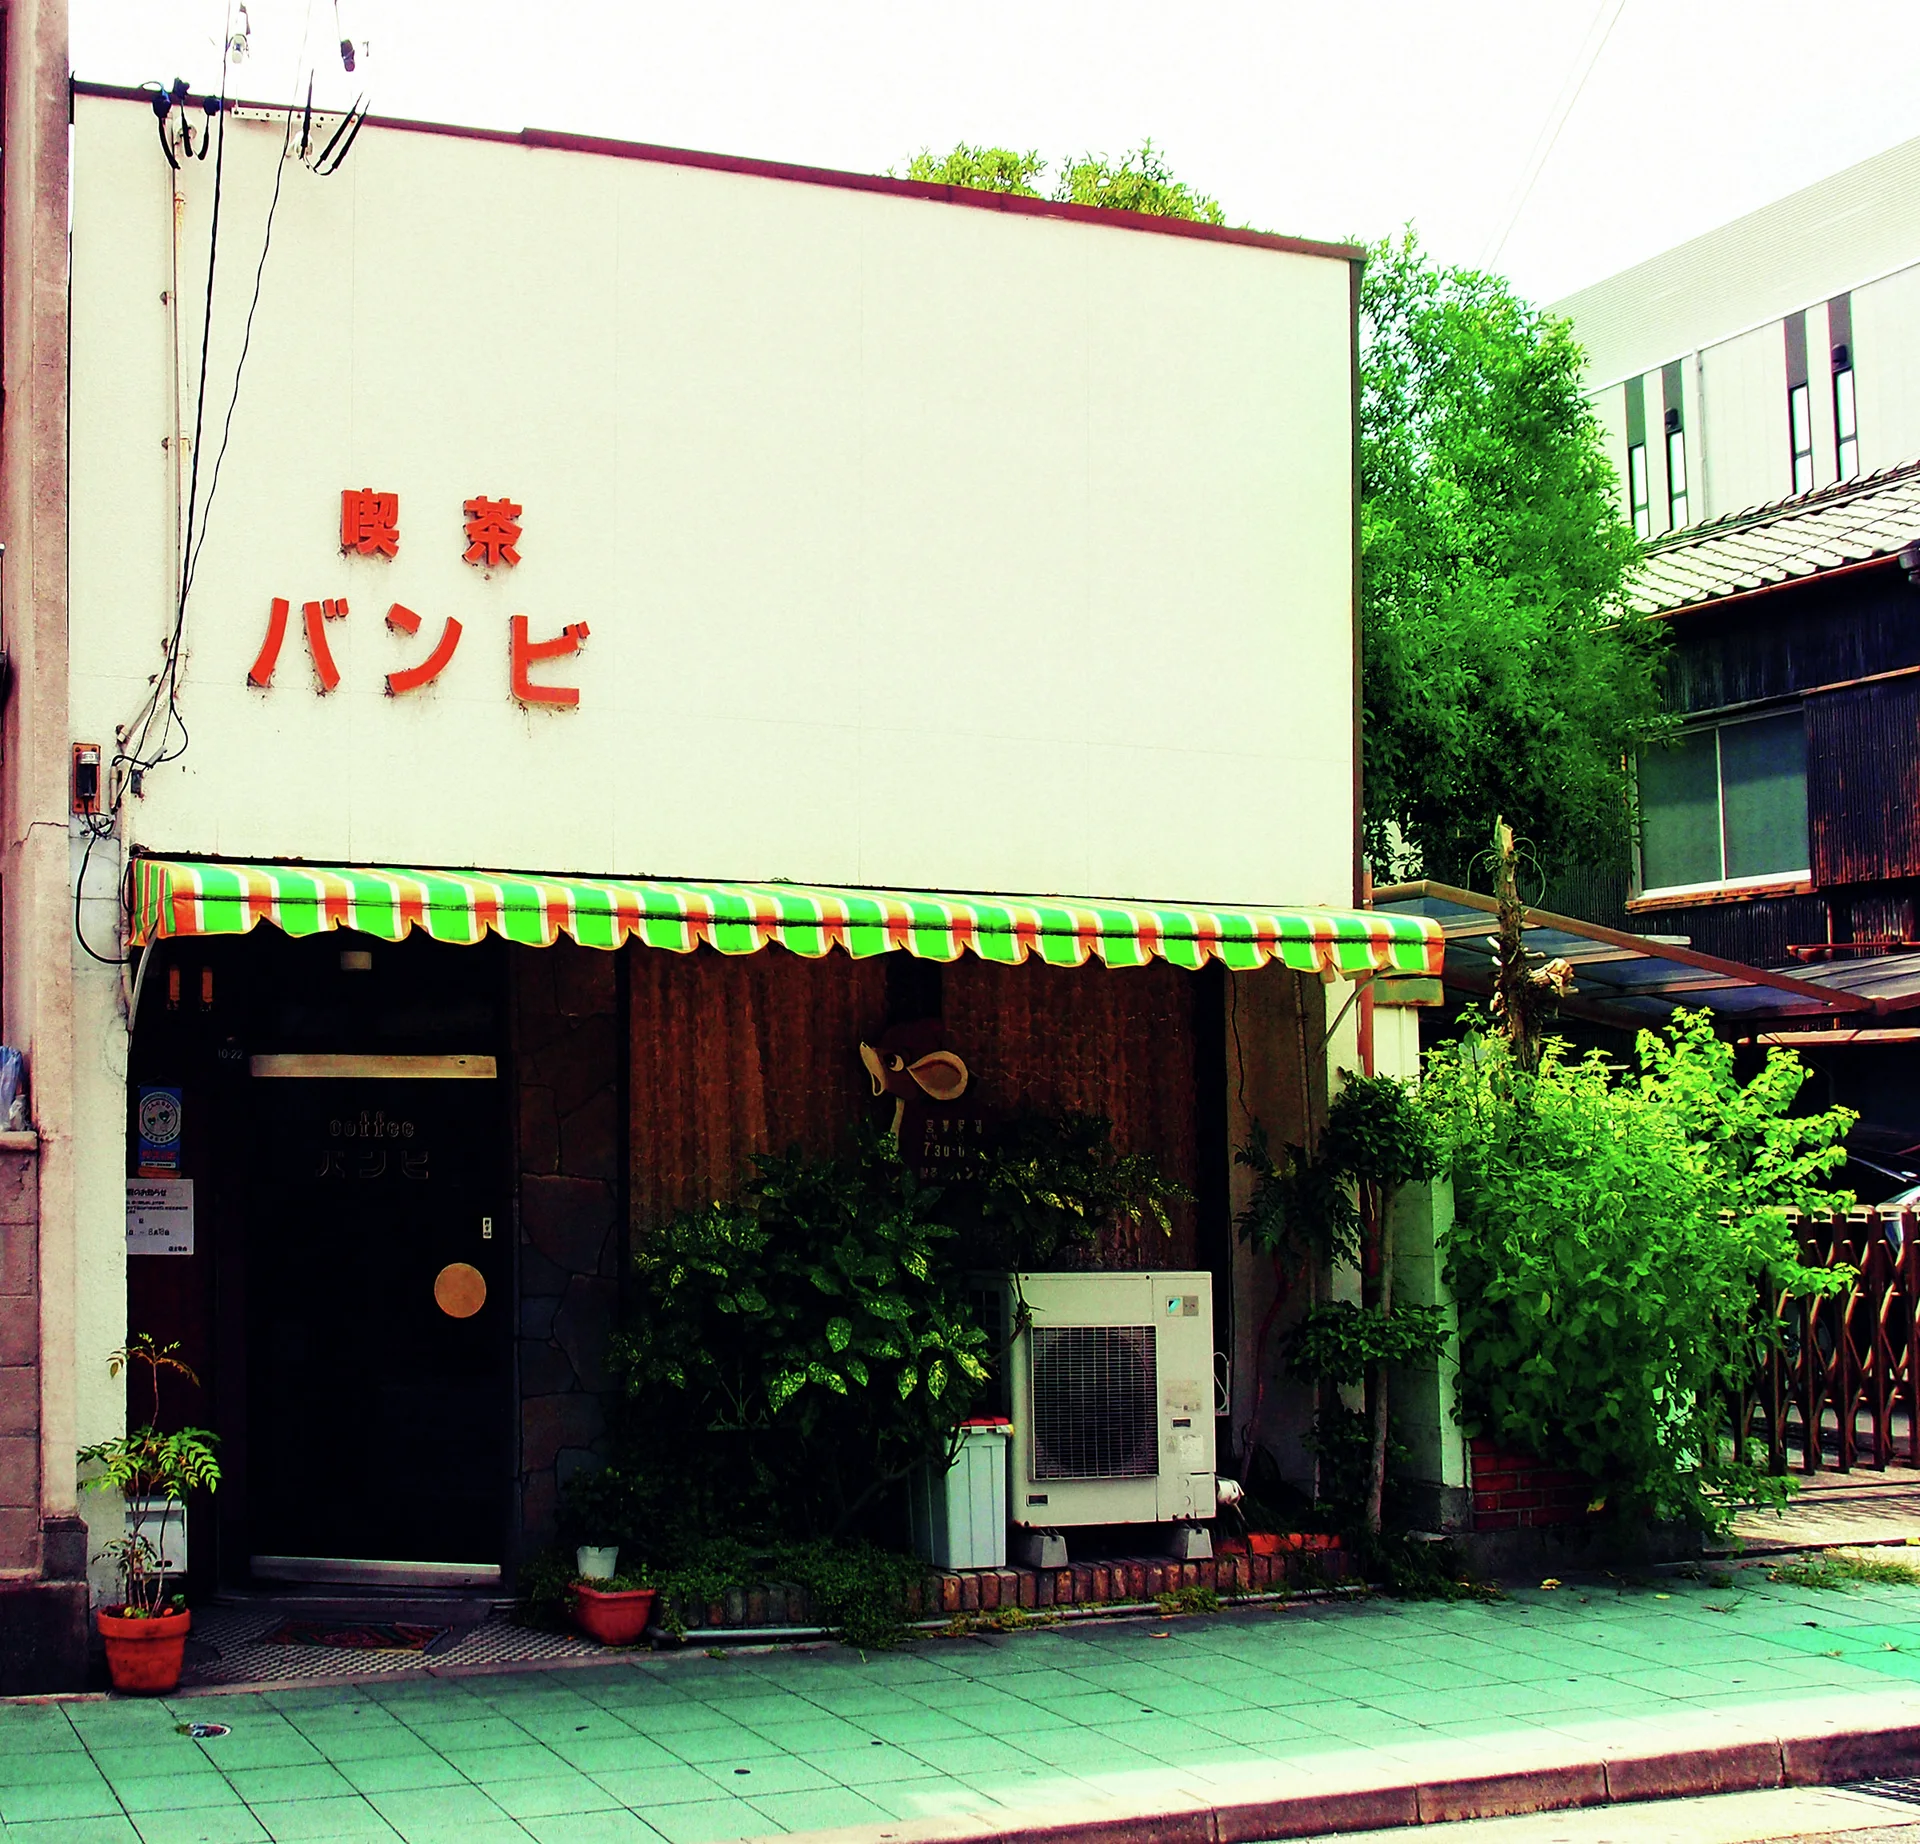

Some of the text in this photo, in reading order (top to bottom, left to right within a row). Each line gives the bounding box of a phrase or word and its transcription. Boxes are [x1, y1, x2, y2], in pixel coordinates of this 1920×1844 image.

[341, 488, 523, 567] 喫茶
[248, 597, 591, 706] バンビ
[328, 1108, 416, 1138] coffee
